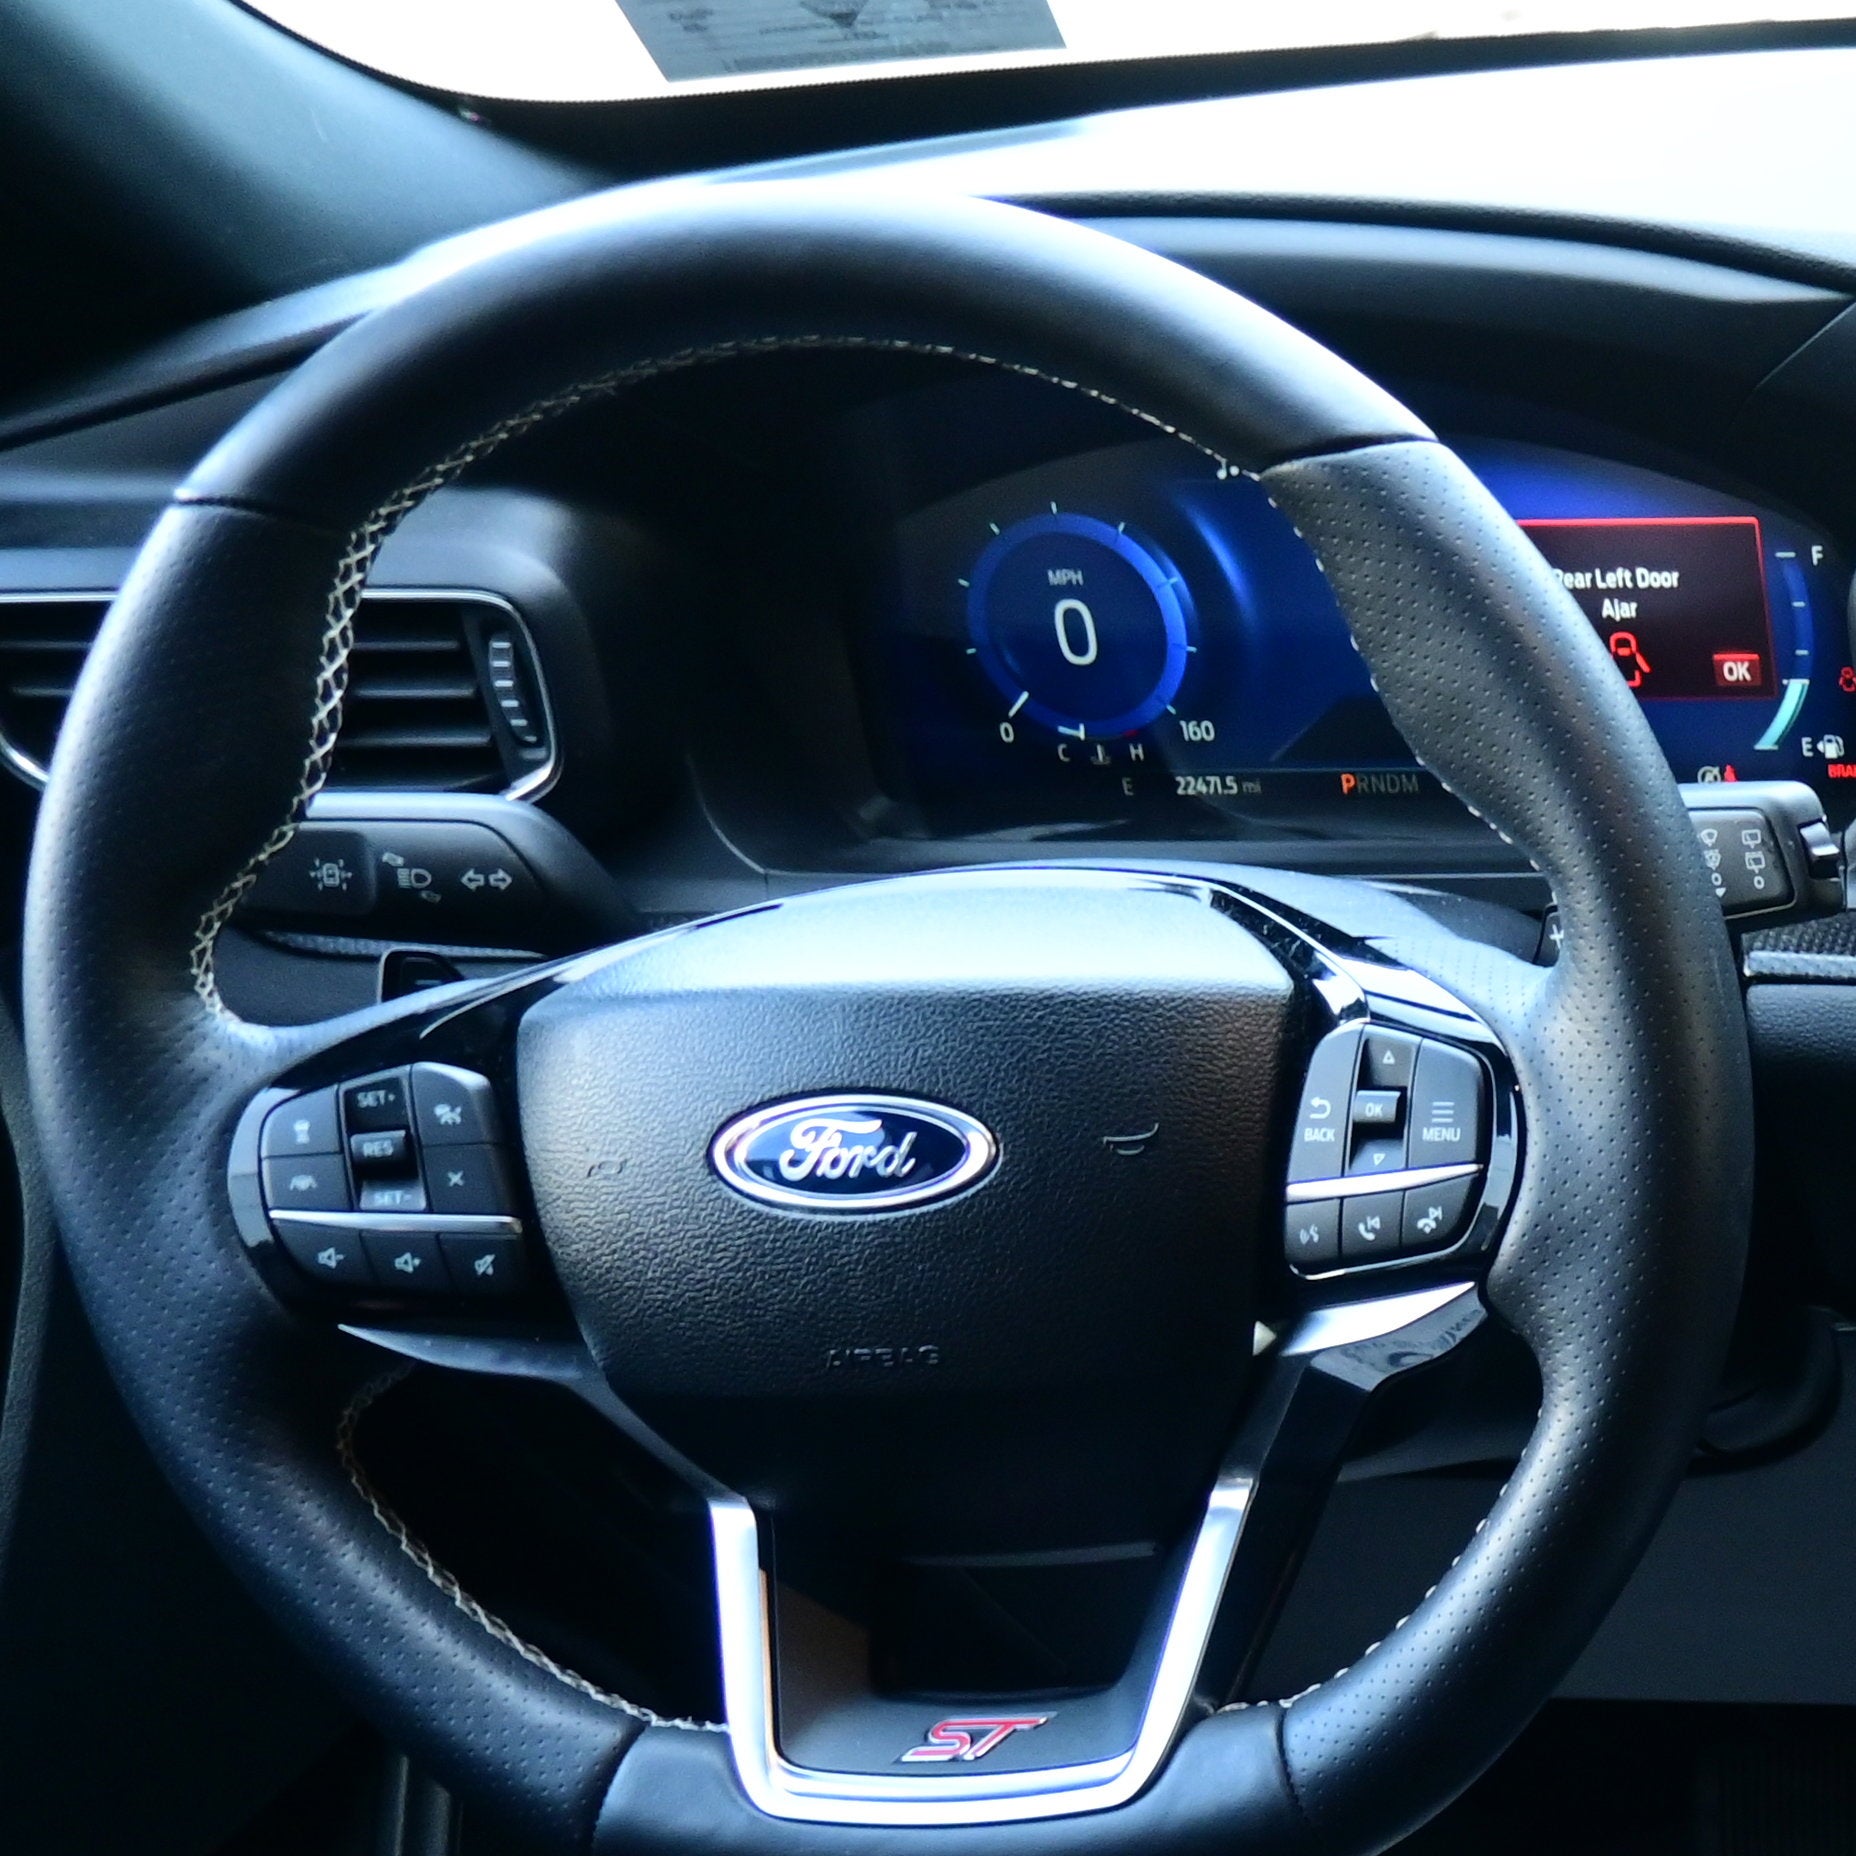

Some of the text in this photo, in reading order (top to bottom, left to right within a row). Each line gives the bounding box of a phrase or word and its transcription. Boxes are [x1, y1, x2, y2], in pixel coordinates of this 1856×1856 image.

[1811, 545, 1823, 566] F
[1047, 569, 1083, 587] MPH
[1595, 567, 1633, 590] Left
[1636, 567, 1679, 589] Door
[1601, 598, 1638, 621] Ajar
[1053, 598, 1099, 667] 0
[1723, 661, 1752, 682] OK
[1000, 722, 1015, 744] 0
[1179, 719, 1216, 743] 160
[1057, 743, 1071, 762] C
[1129, 743, 1145, 762] H
[1801, 736, 1813, 758] E
[1364, 1102, 1384, 1118] OK
[1303, 1126, 1336, 1143] BACK
[1421, 1126, 1462, 1143] MENU
[362, 1139, 394, 1158] RES
[778, 1117, 917, 1181] Ford
[900, 1715, 1049, 1763] ST
